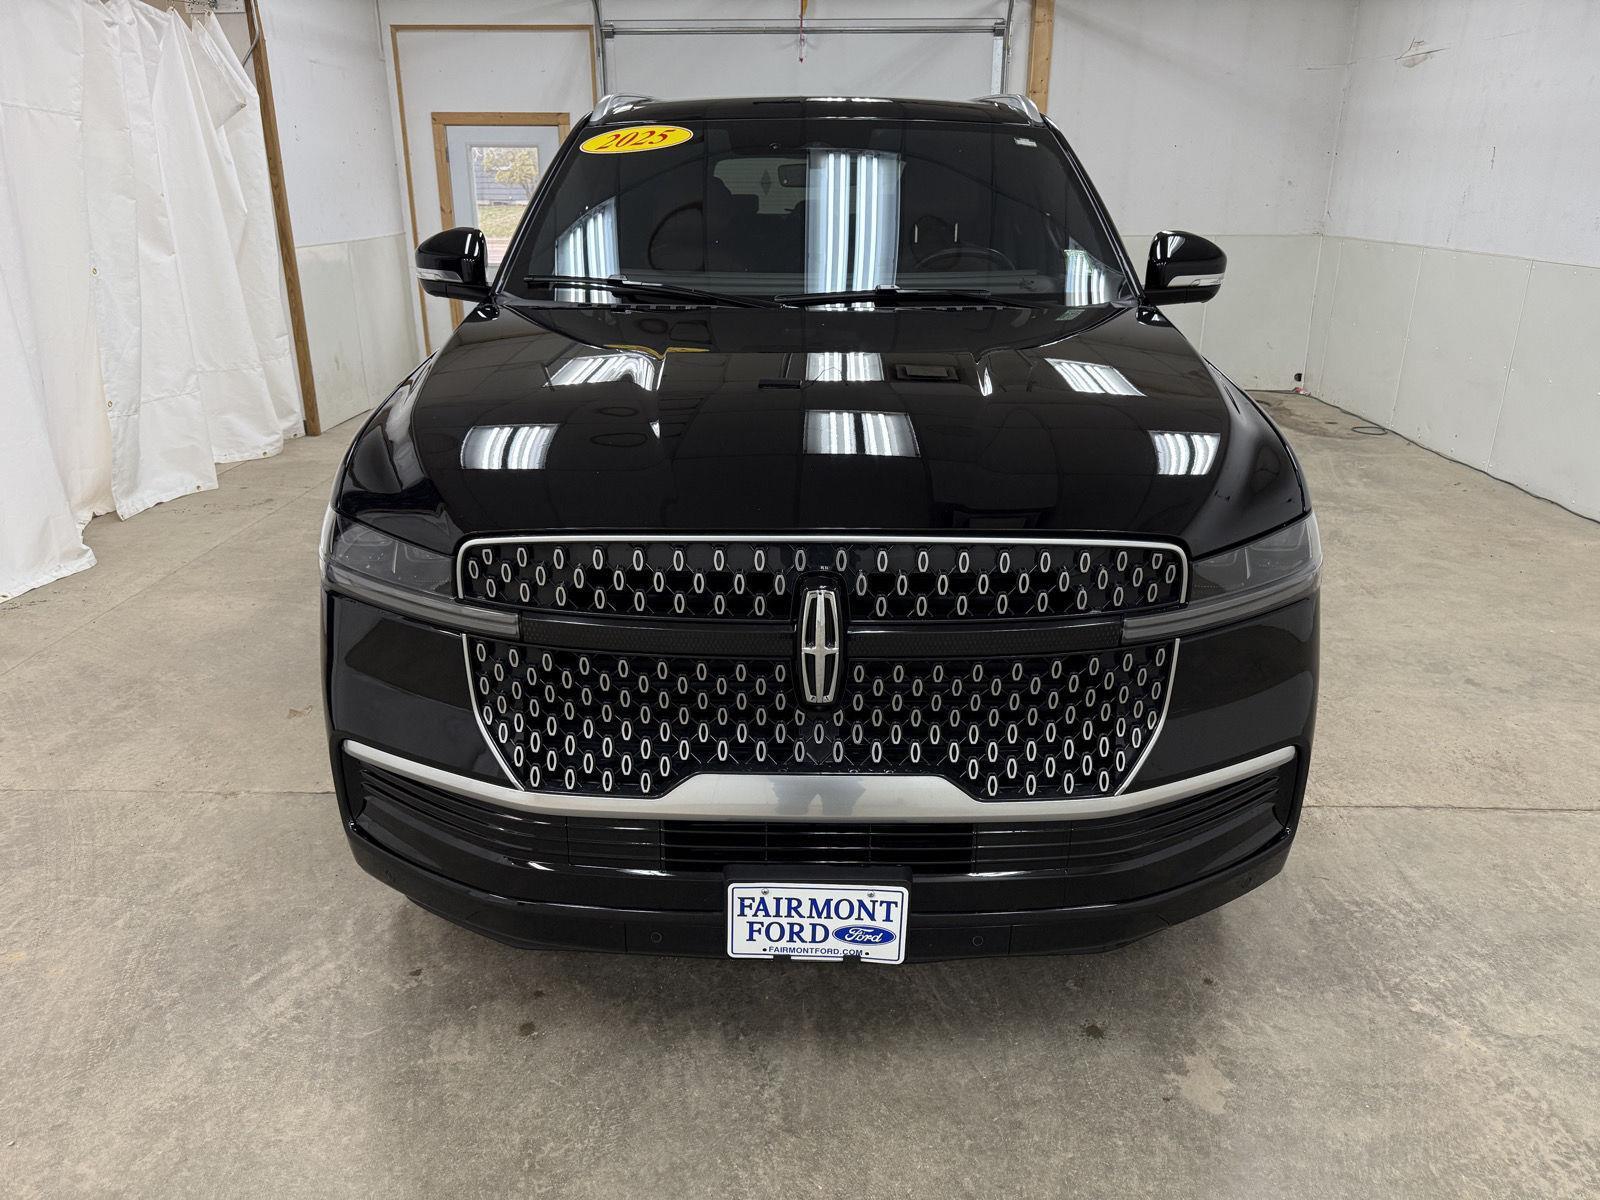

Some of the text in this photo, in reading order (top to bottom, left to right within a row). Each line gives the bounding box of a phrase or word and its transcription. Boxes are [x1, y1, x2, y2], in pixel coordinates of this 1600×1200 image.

[595, 129, 675, 150] 2025
[737, 896, 898, 922] FAIRMONT
[746, 921, 829, 943] FORD
[845, 927, 882, 943] Ford
[768, 946, 863, 956] FAIRMONTFORD.COM
